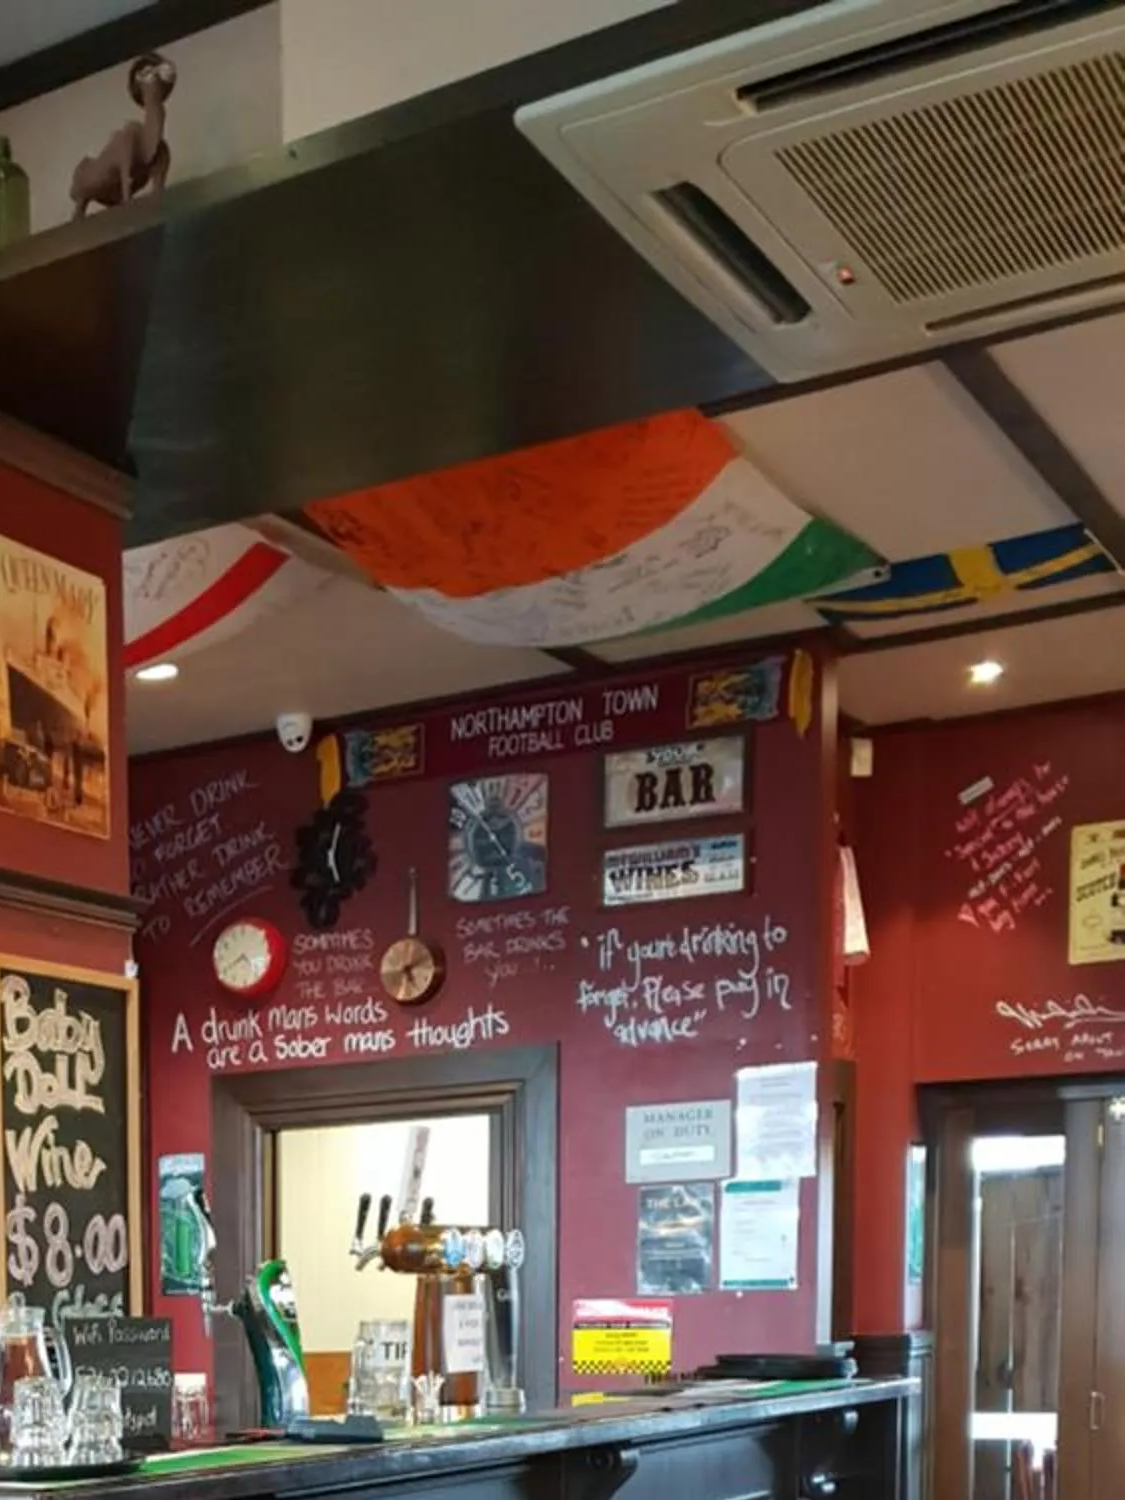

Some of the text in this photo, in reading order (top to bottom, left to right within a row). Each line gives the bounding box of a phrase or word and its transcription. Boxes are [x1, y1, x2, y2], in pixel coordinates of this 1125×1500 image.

[450, 684, 659, 741] NORTHAMPTON TOWN
[488, 719, 614, 758] FOOTBALL CLUB
[634, 762, 716, 813] BAR
[607, 858, 700, 894] WINES
[763, 914, 788, 951] to
[765, 966, 792, 1010] in
[0, 974, 105, 1086] Baby
[171, 1012, 194, 1052] A
[201, 1006, 263, 1045] drunk
[207, 1045, 244, 1070] are
[405, 1003, 510, 1049] thoughts
[643, 1108, 714, 1125] MANAGER
[674, 1125, 712, 1138] DUTY
[4, 1114, 108, 1193] Wine
[6, 1192, 129, 1288] $8.00
